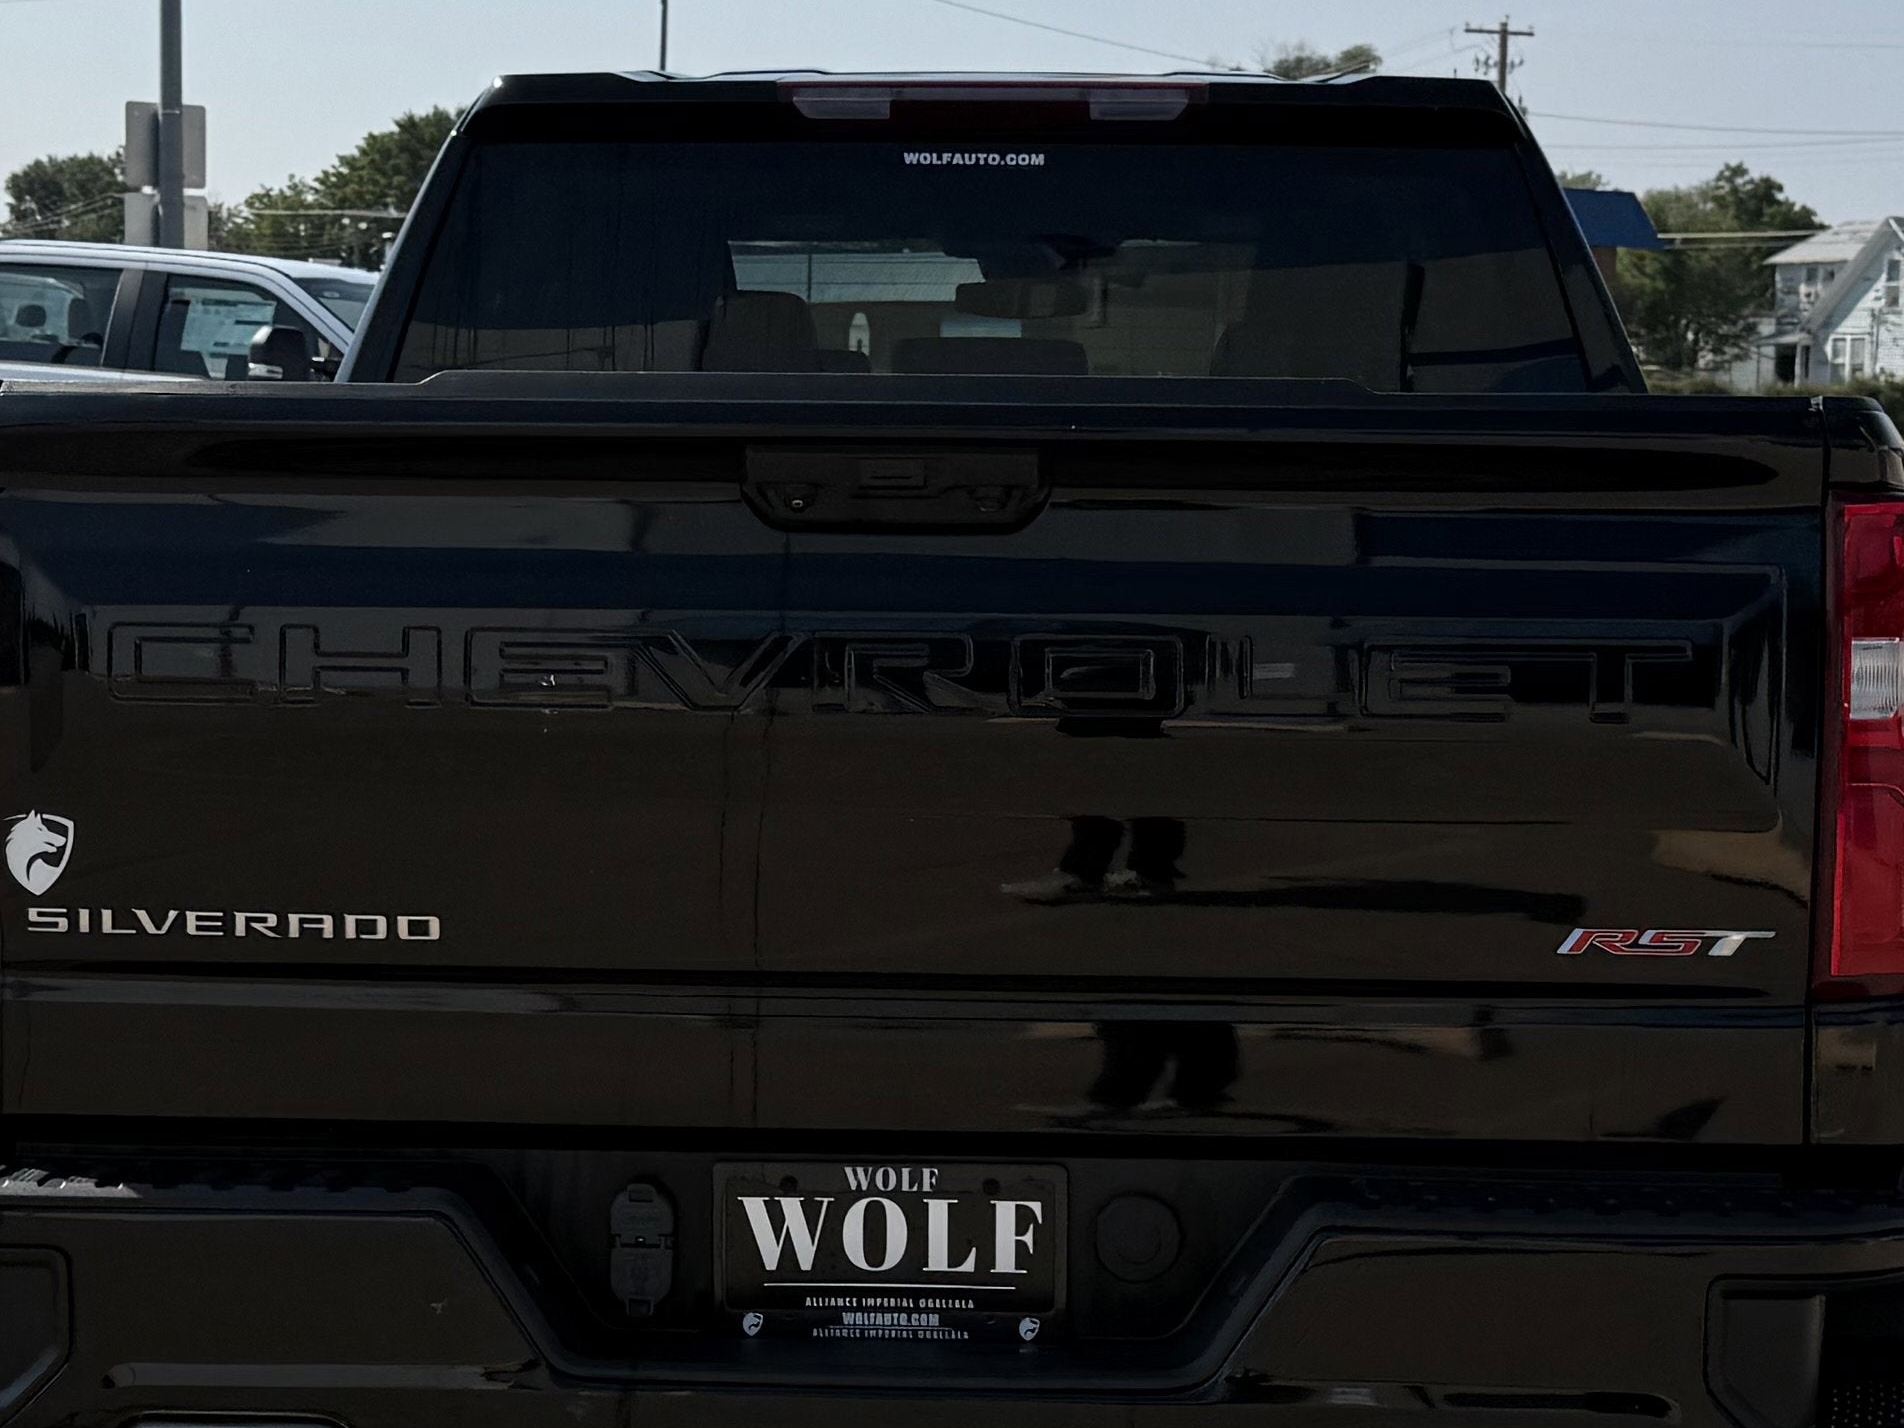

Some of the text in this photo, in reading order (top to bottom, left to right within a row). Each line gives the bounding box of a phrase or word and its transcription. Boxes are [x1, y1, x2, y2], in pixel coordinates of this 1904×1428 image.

[903, 152, 1045, 166] WOLFAUTO.COM
[27, 908, 441, 940] SILVERADO
[1556, 928, 1777, 957] RST
[844, 1166, 939, 1192] WOLF
[737, 1197, 1043, 1274] WOLF
